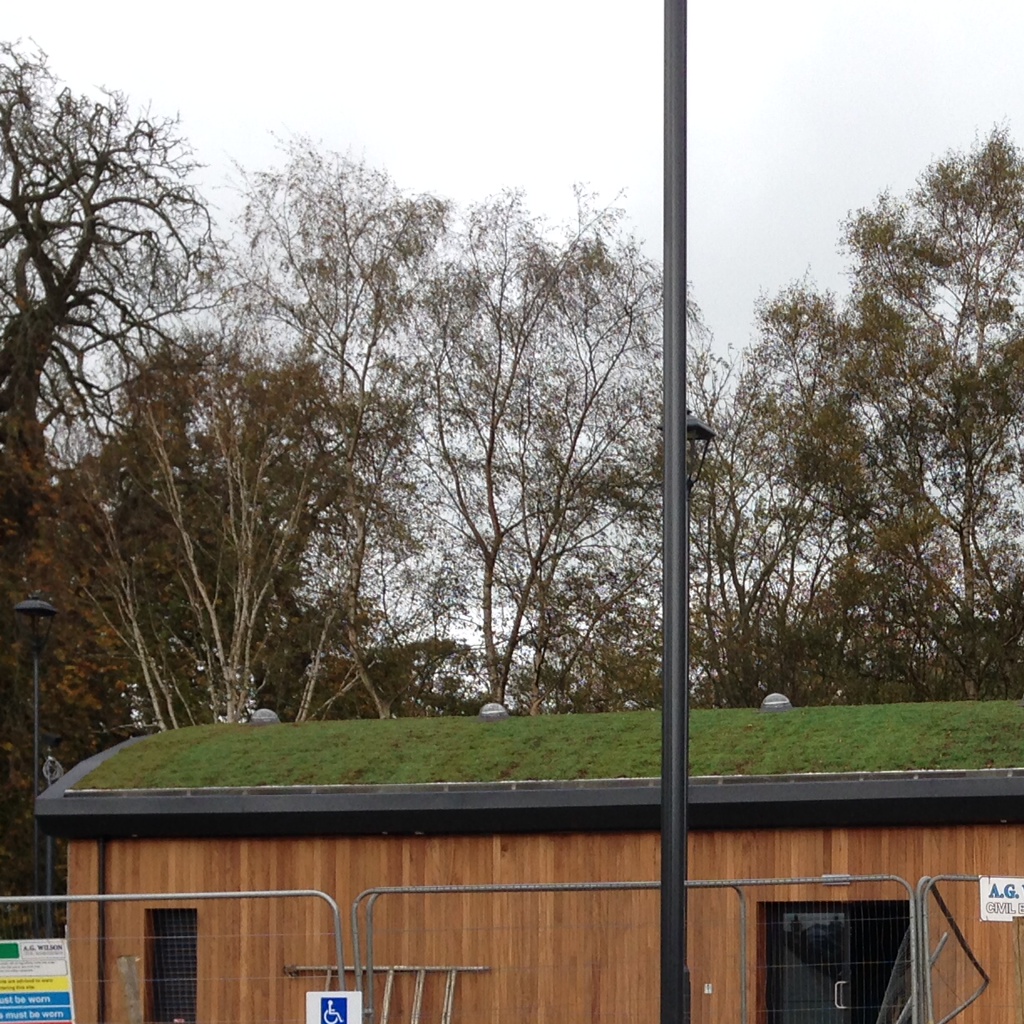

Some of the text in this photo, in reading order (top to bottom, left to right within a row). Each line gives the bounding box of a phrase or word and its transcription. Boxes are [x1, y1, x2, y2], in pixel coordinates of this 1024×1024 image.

[988, 883, 1020, 899] A.G.
[985, 902, 1016, 914] CIVIL
[0, 995, 51, 1004] ust be worn
[5, 1010, 27, 1019] must
[28, 1010, 41, 1019] be
[41, 1010, 64, 1018] worn
